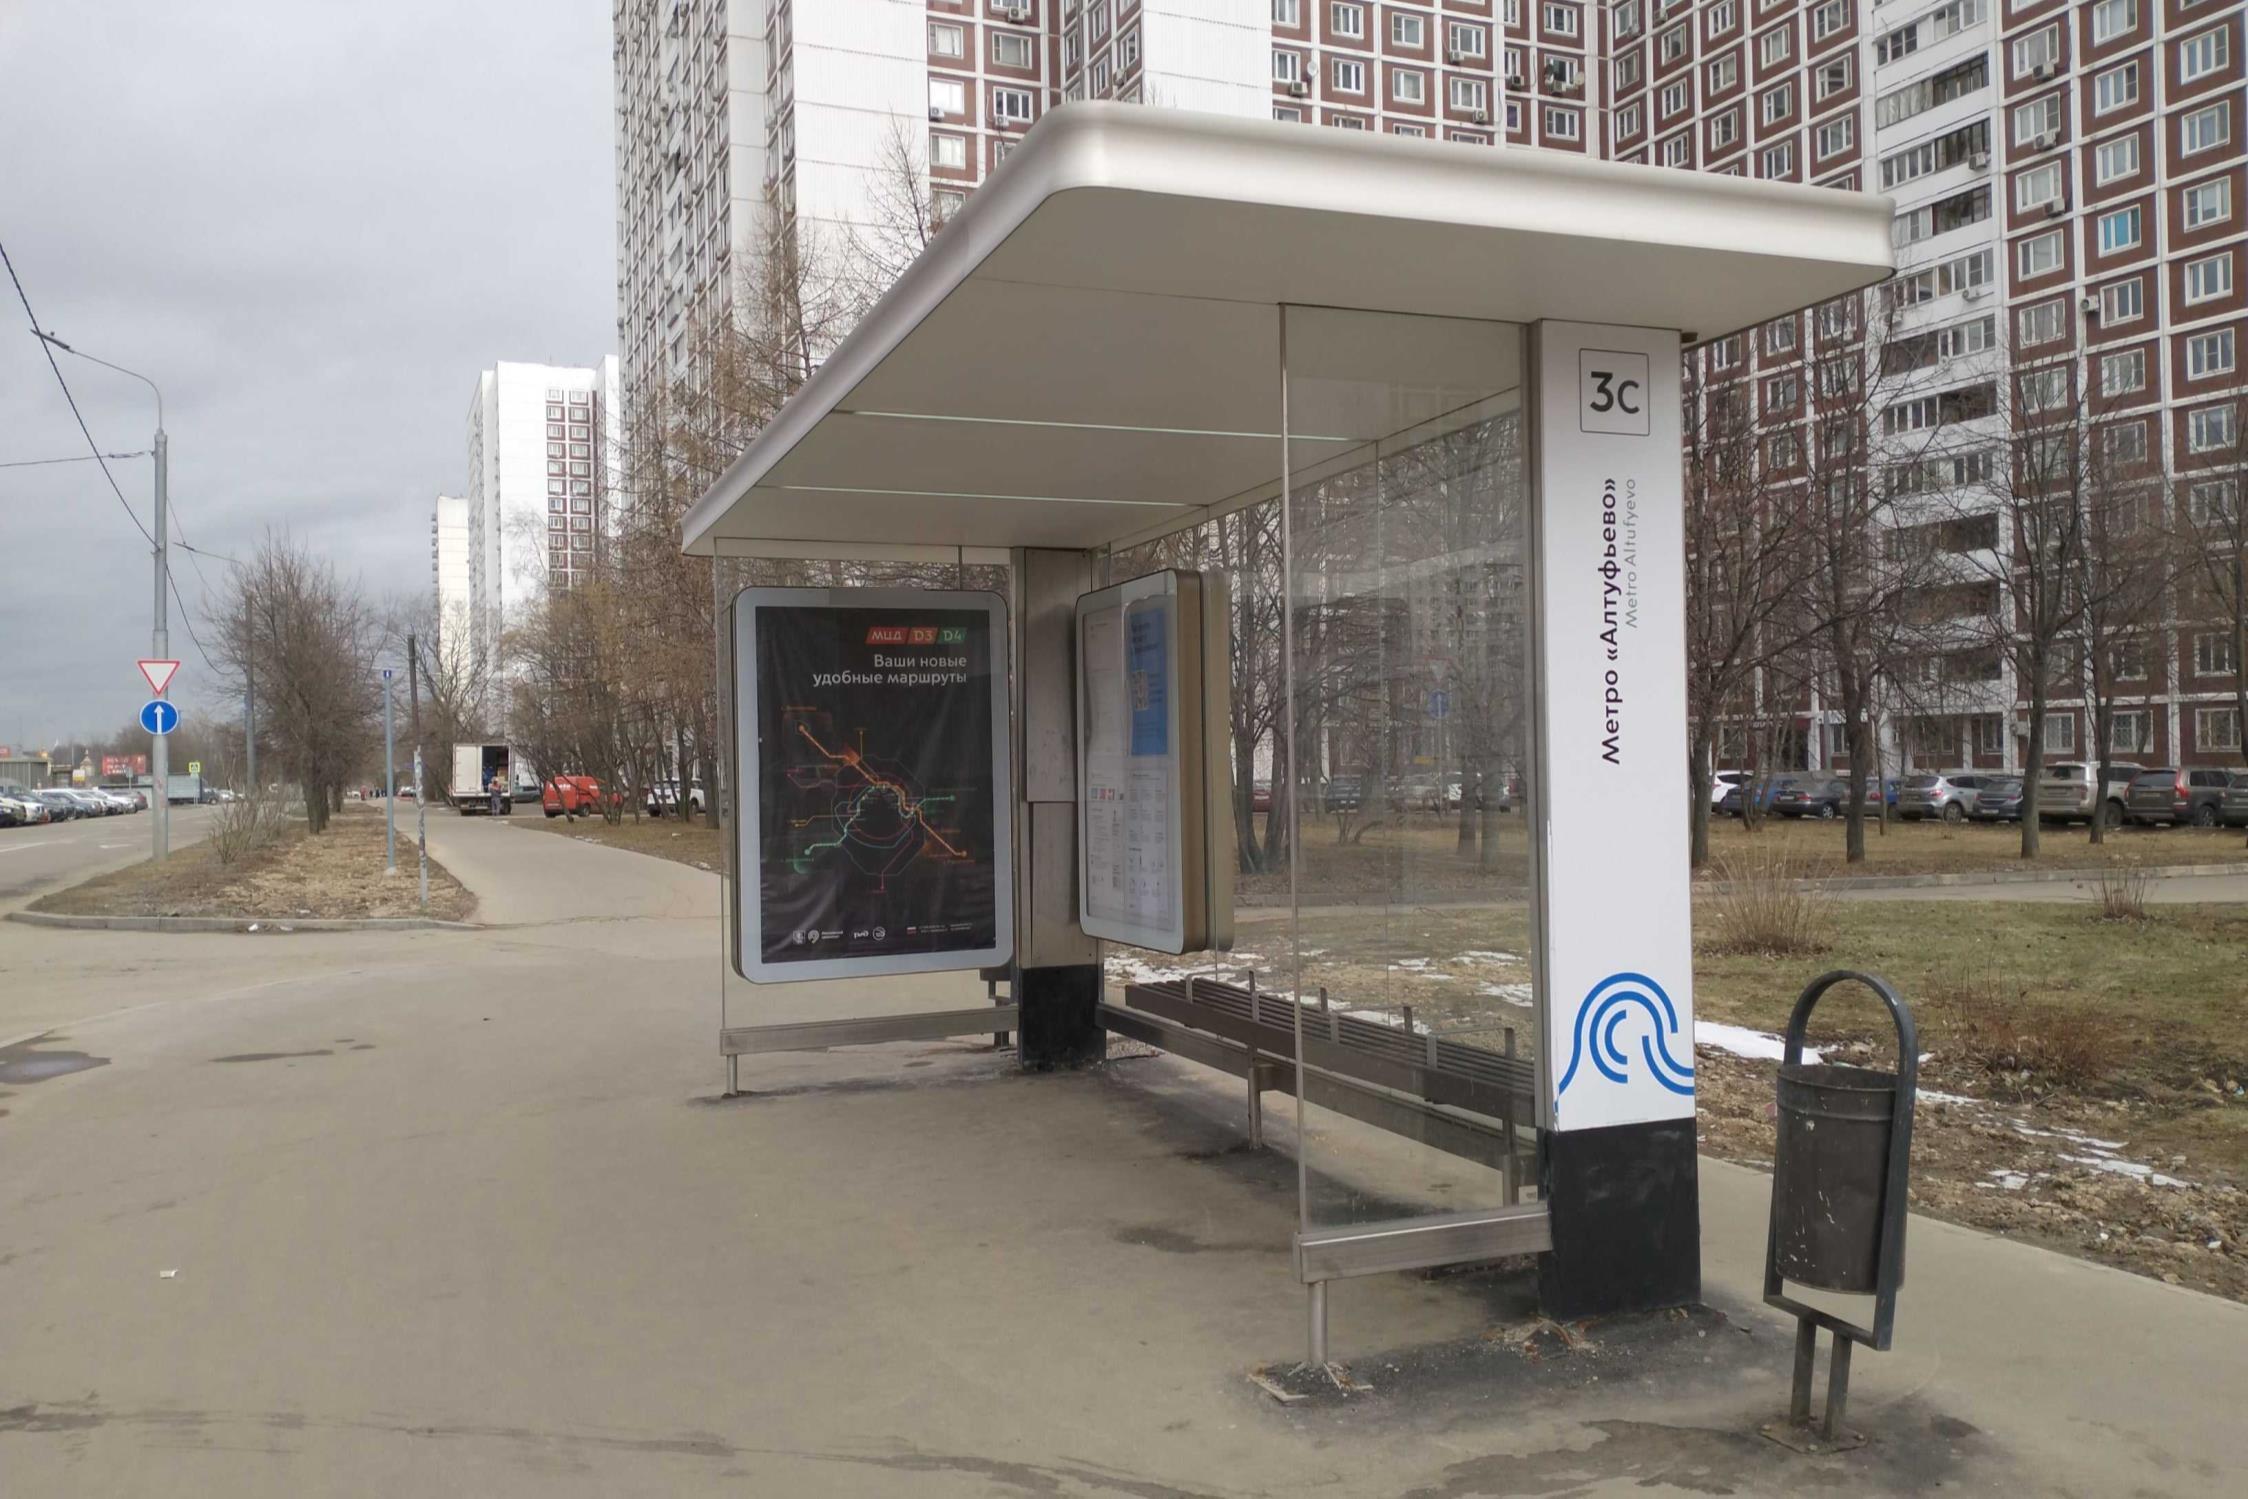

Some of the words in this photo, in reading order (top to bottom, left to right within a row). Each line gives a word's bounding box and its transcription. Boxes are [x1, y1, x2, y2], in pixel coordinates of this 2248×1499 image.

[1623, 478, 1639, 567] Altufyevo
[1597, 478, 1622, 661] «Алтуфьево»
[1625, 571, 1638, 629] Metro
[873, 653, 916, 668] Ваши
[920, 655, 968, 668] новые
[914, 630, 933, 642] D3
[944, 630, 963, 641] D4
[812, 670, 884, 688] удобные
[887, 672, 967, 687] маршруты
[1601, 669, 1622, 765] Метро
